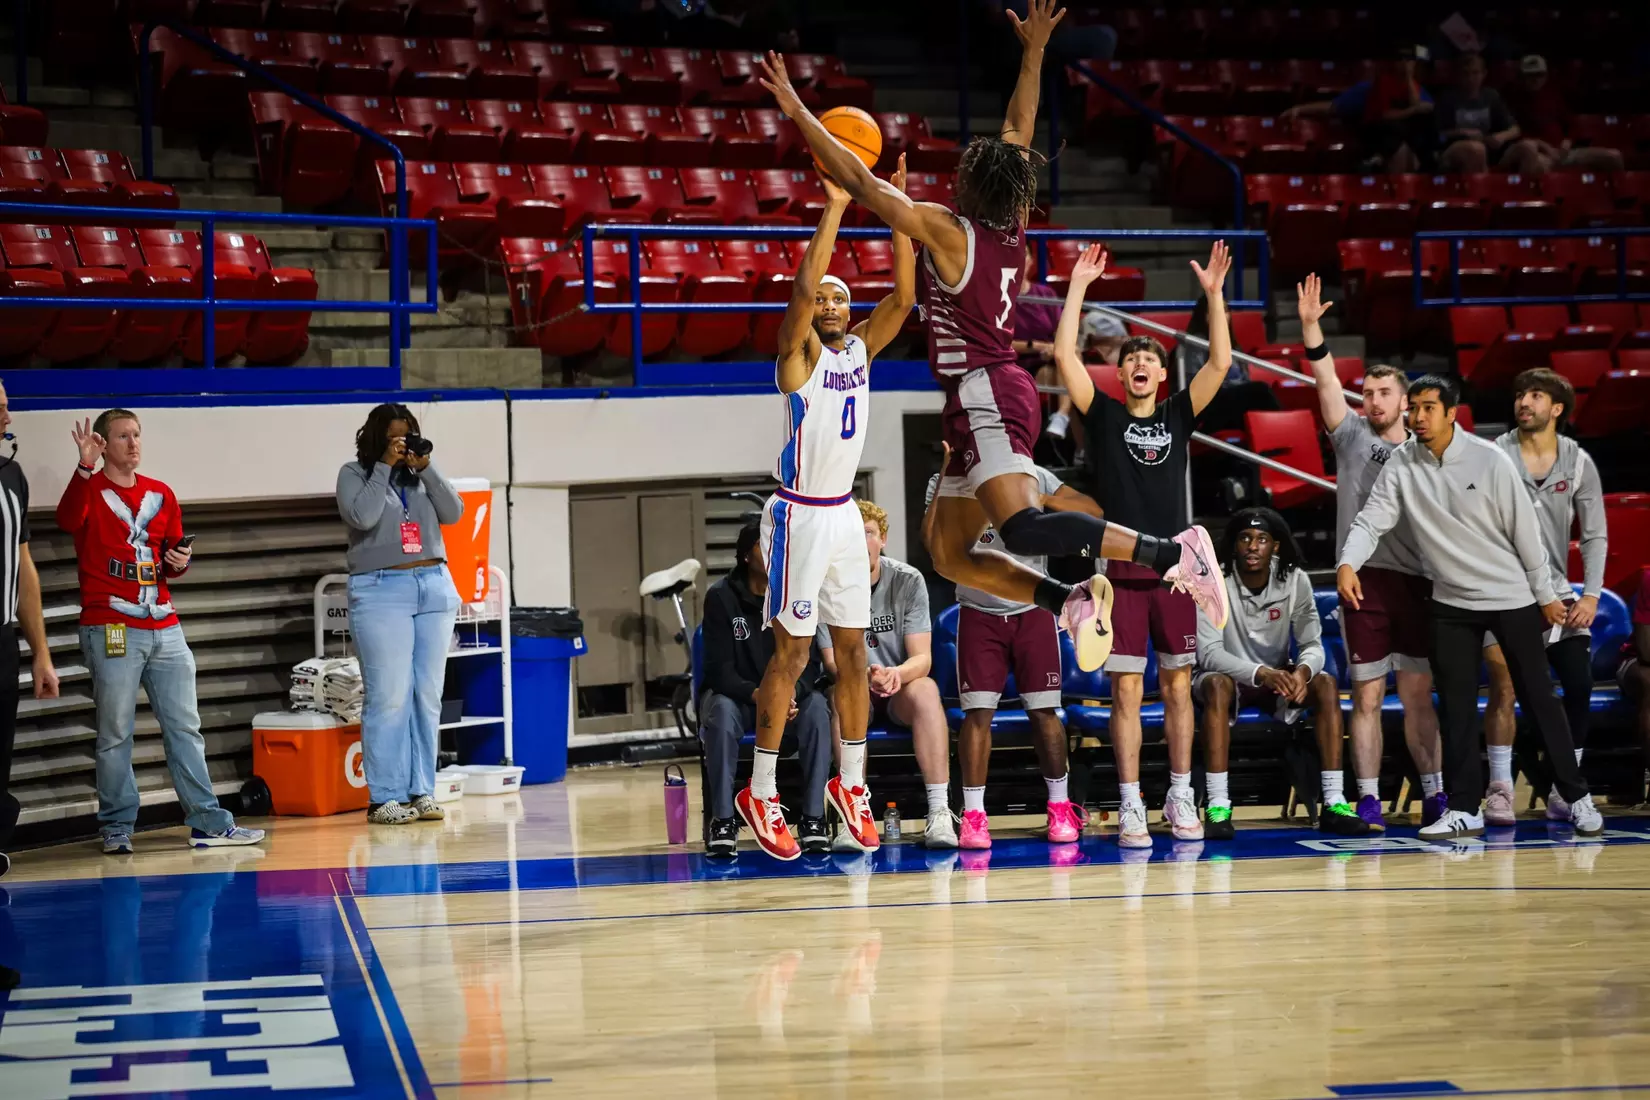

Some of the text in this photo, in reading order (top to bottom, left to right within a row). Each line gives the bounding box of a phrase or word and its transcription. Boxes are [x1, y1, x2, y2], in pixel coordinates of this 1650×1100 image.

[995, 267, 1018, 331] 5
[840, 395, 856, 440] 0
[327, 607, 348, 618] GAT
[111, 629, 124, 638] ALL
